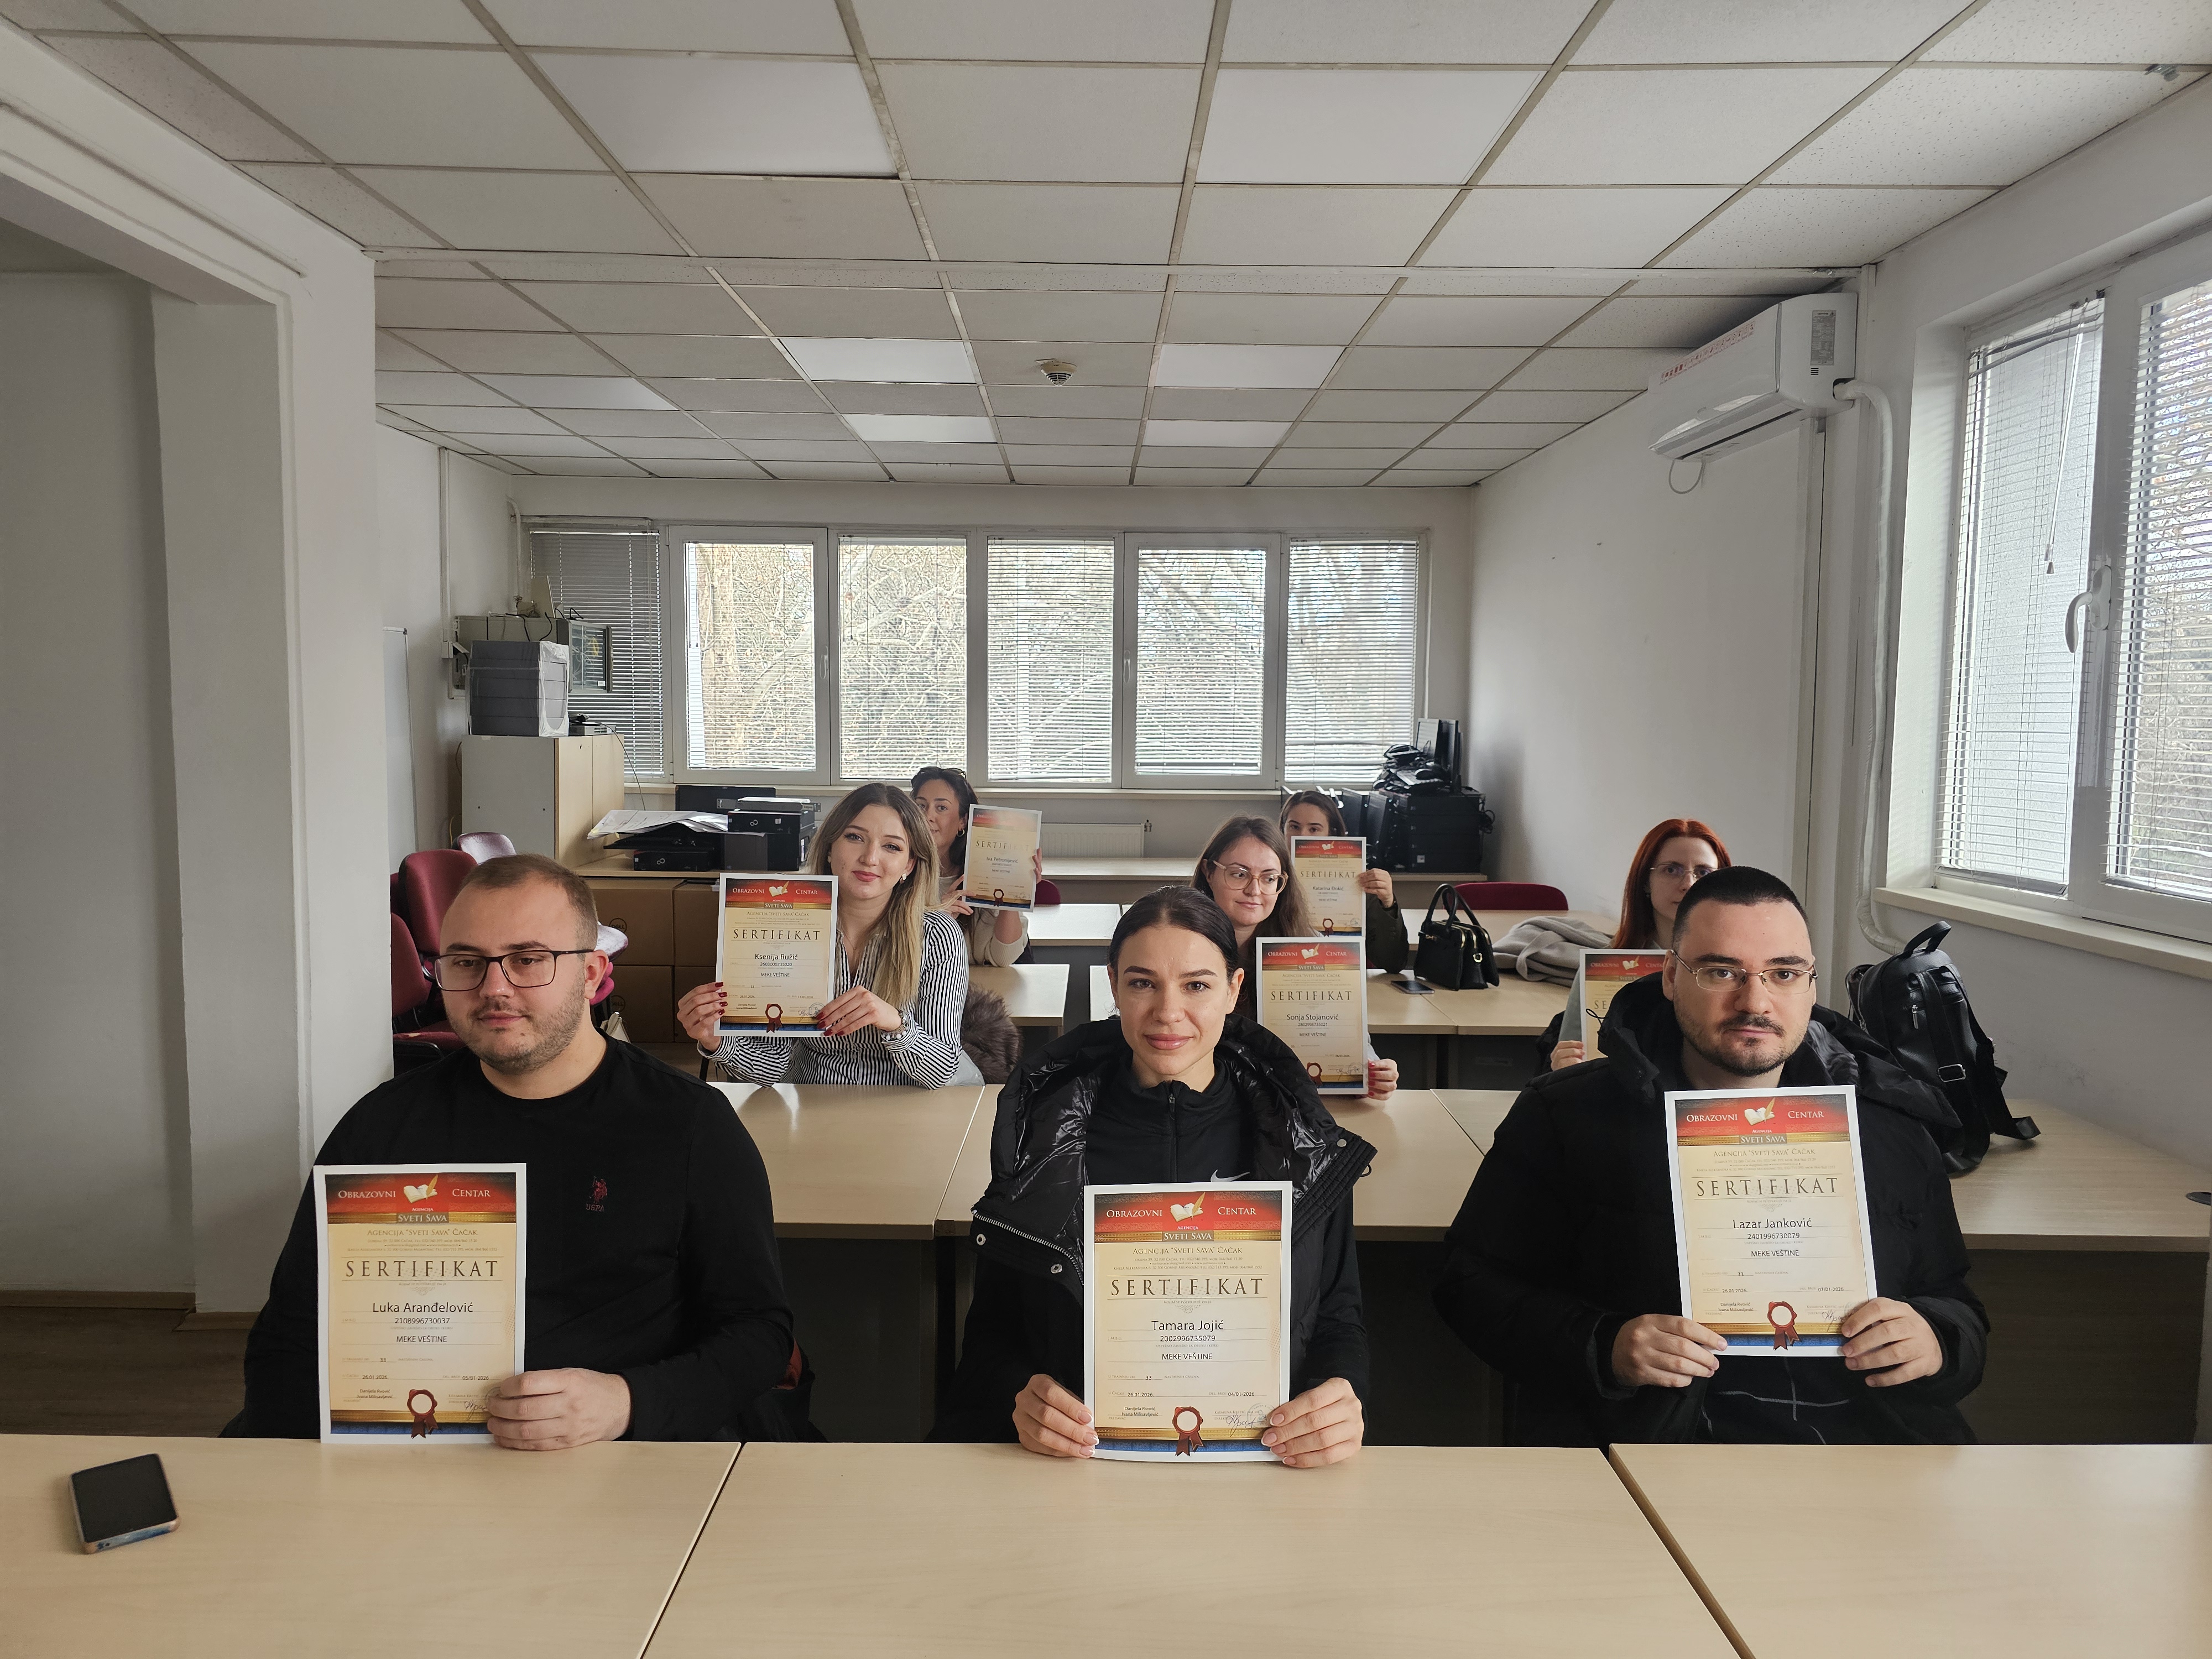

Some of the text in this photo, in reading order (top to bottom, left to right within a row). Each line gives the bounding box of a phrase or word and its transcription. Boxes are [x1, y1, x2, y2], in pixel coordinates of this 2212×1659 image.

[976, 840, 1029, 851] SERTIFIT
[733, 929, 820, 940] SERTIFIKAT
[1271, 991, 1352, 1000] SERTIFIKAT
[1686, 1110, 1824, 1123] OBRAZOVNI CENTAR
[1741, 1136, 1764, 1144] SVETI
[1697, 1177, 1838, 1196] SERTIFIKAT
[338, 1188, 491, 1198] OBRAZOVNI CENTAR
[586, 1203, 604, 1212] USPA
[1106, 1207, 1256, 1218] OBRAZOVNI CENTAR
[1733, 1218, 1812, 1229] Lazar Janković
[346, 1260, 498, 1277] SERTIFIKAT
[1111, 1278, 1263, 1296] SERTIFIKAT
[373, 1302, 473, 1313] Luka Aranđelović
[1151, 1320, 1224, 1332] Tamara Jojić
[1183, 1352, 1213, 1360] VEŠTINE
